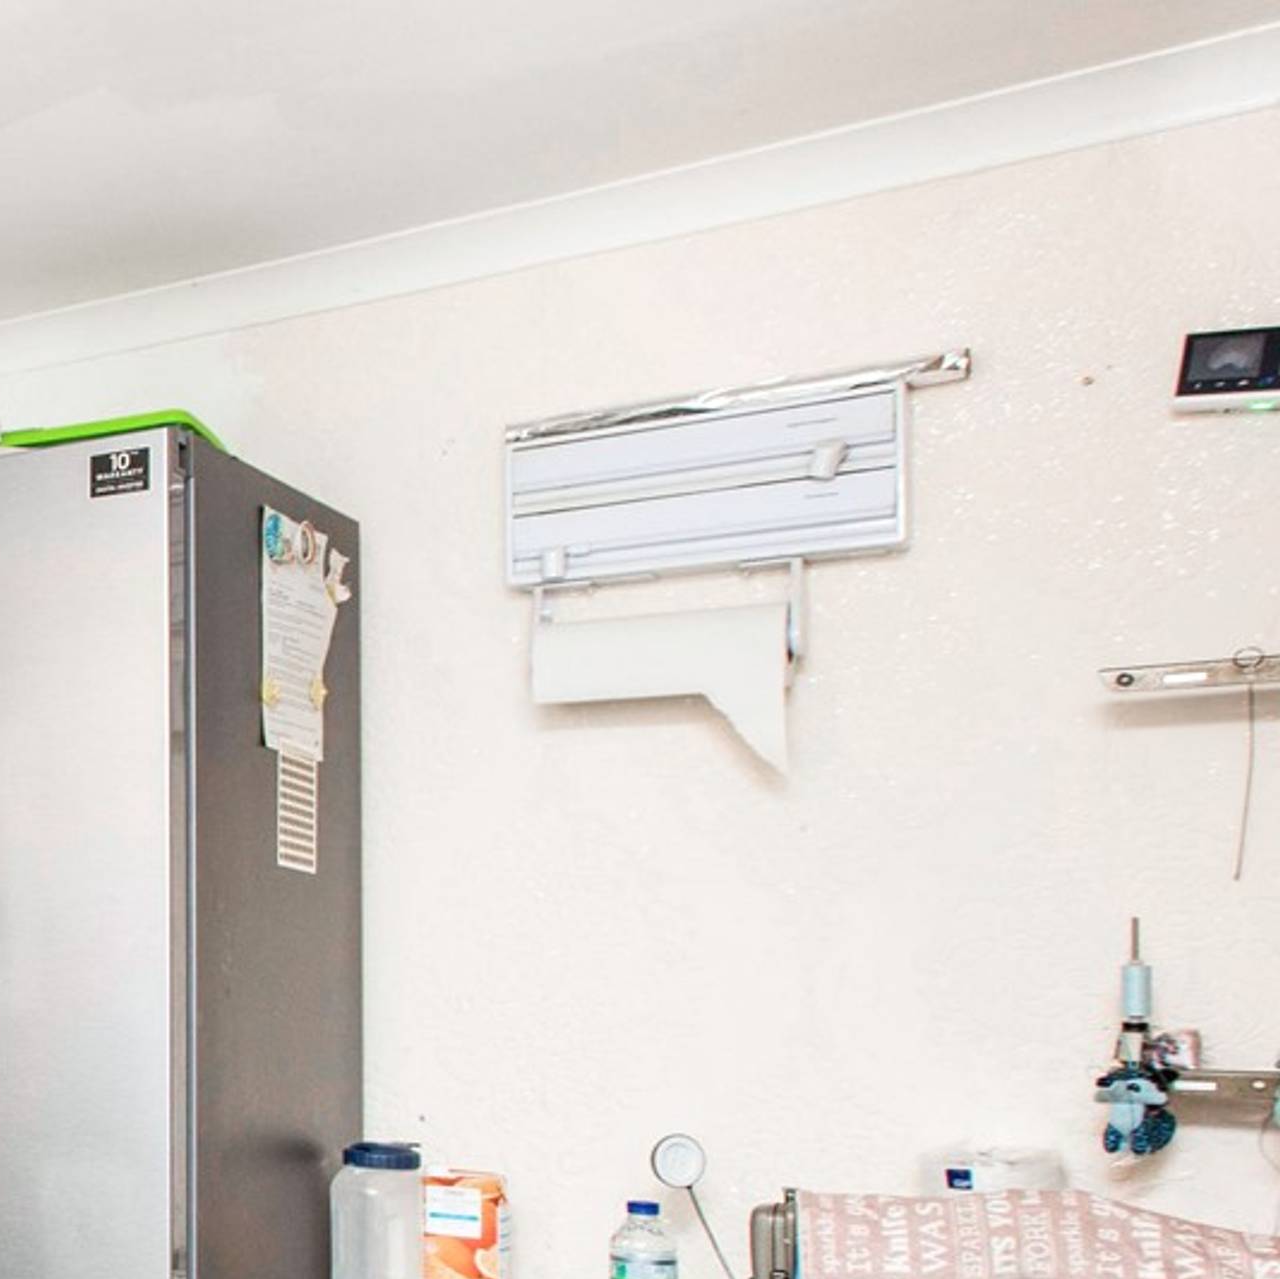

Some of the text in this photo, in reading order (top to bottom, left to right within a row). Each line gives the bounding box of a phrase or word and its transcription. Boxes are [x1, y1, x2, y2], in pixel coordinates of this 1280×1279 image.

[109, 453, 130, 471] 10
[915, 1202, 947, 1273] WAS
[990, 1236, 1017, 1274] ITS
[1023, 1211, 1052, 1273] FORK
[1060, 1211, 1088, 1274] sparkle
[1095, 1228, 1123, 1277] It's
